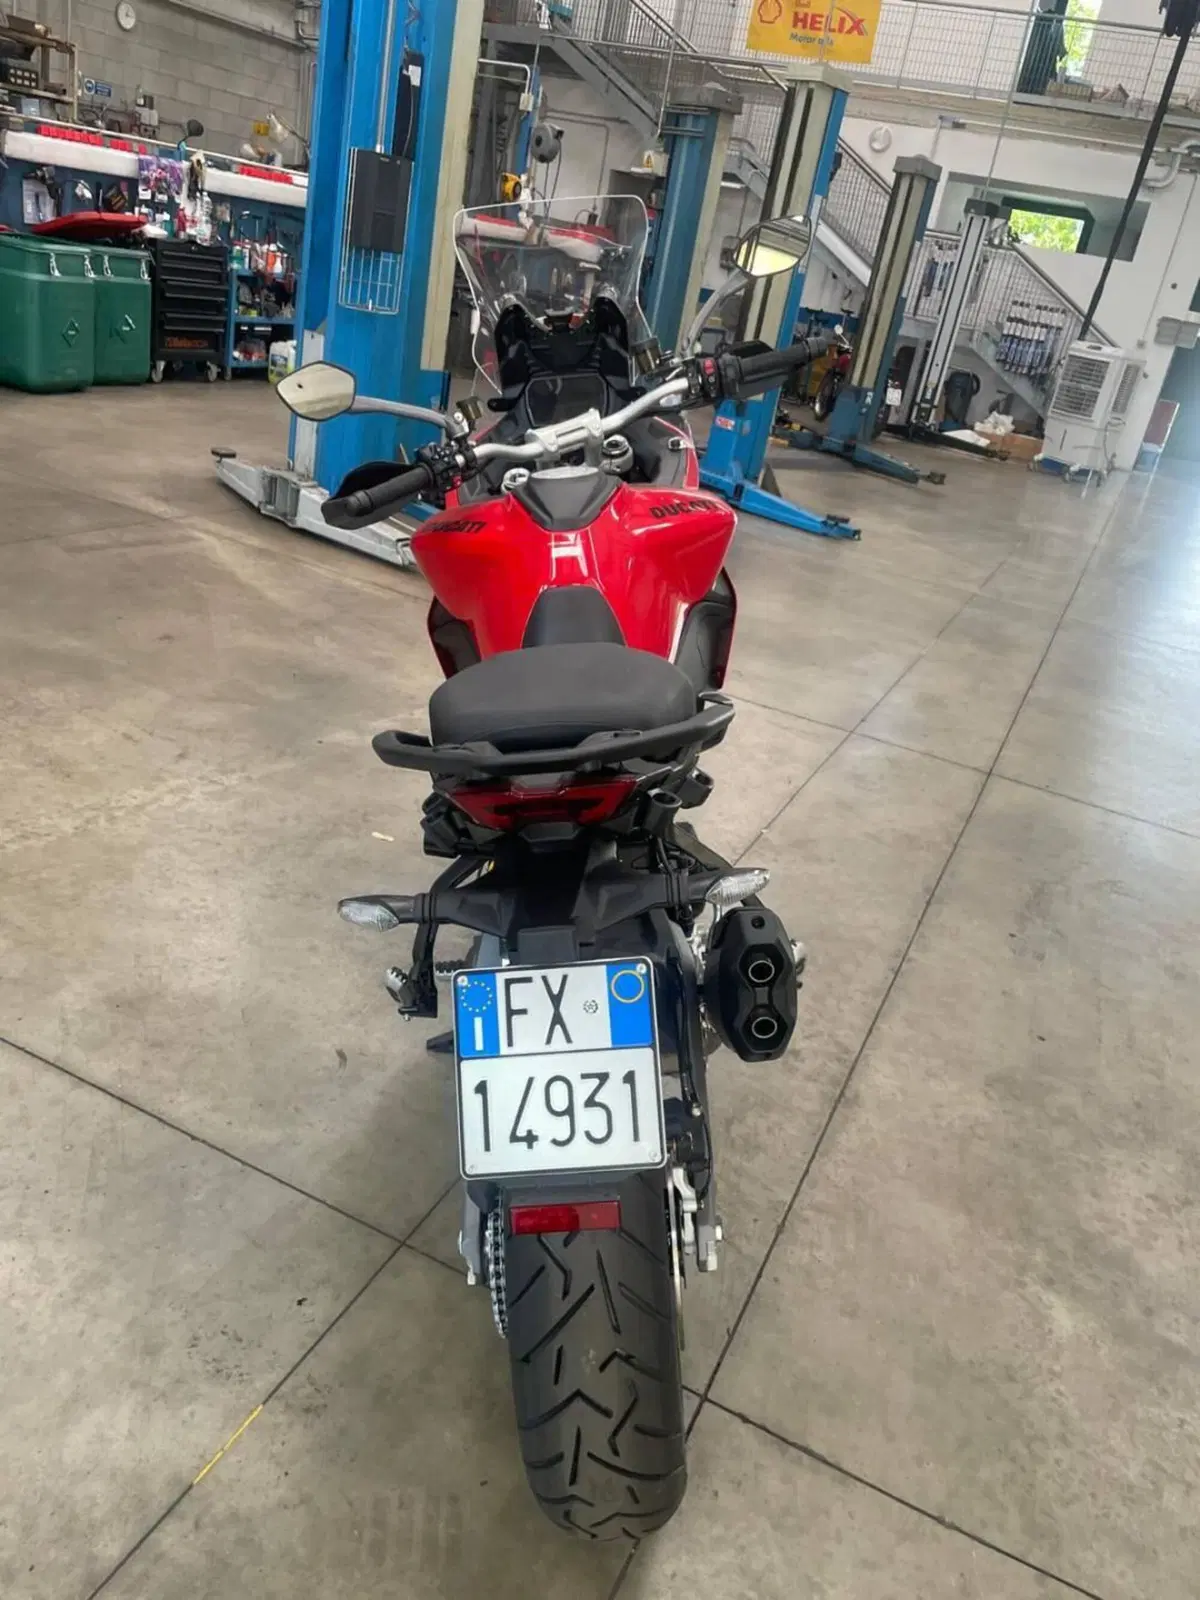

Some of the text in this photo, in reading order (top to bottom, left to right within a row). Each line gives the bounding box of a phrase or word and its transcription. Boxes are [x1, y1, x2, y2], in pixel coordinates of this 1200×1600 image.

[792, 11, 866, 36] HELIX
[473, 1016, 484, 1052] I
[504, 973, 574, 1048] FX
[474, 1069, 641, 1153] 14931
